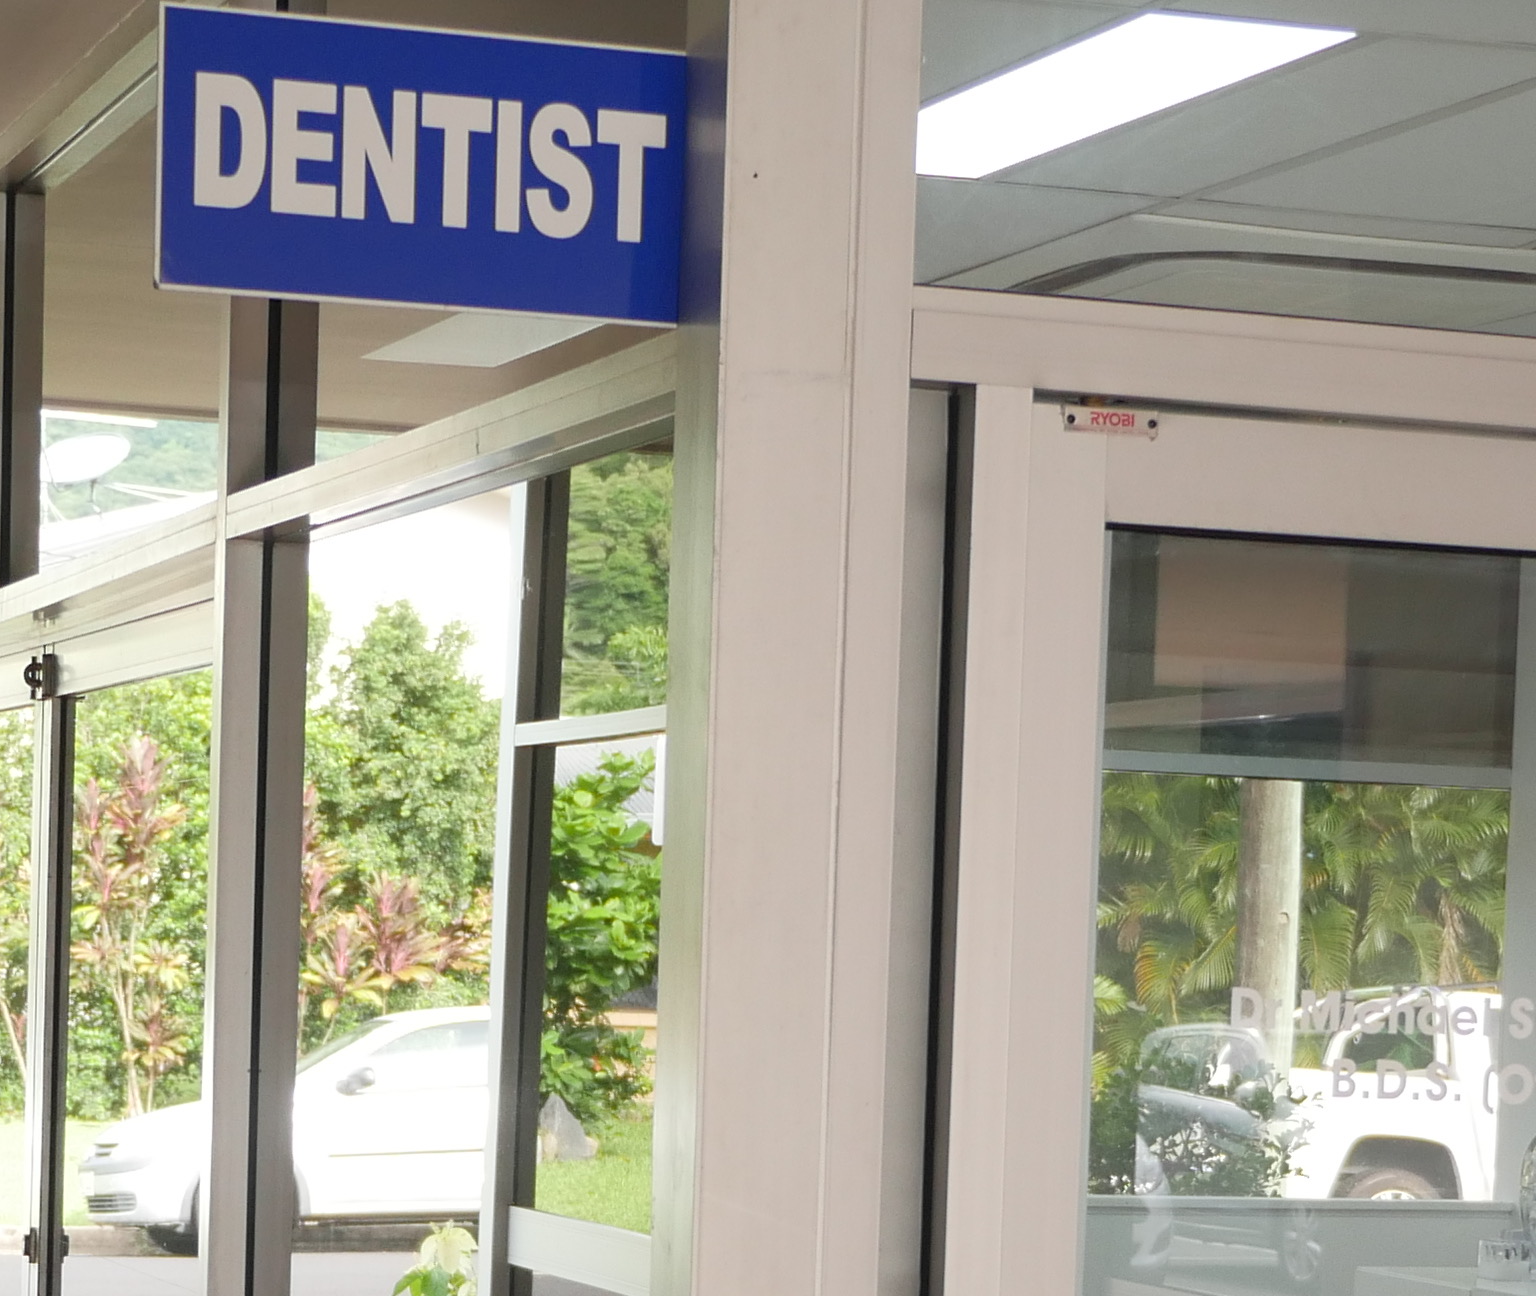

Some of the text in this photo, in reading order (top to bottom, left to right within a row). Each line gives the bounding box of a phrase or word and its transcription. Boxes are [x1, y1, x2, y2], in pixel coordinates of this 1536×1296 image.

[193, 71, 667, 243] DENTIST
[1090, 411, 1135, 427] RYOBI
[1230, 986, 1288, 1031] Dr
[1300, 989, 1492, 1037] Michael
[1332, 1058, 1461, 1102] B.D.S.
